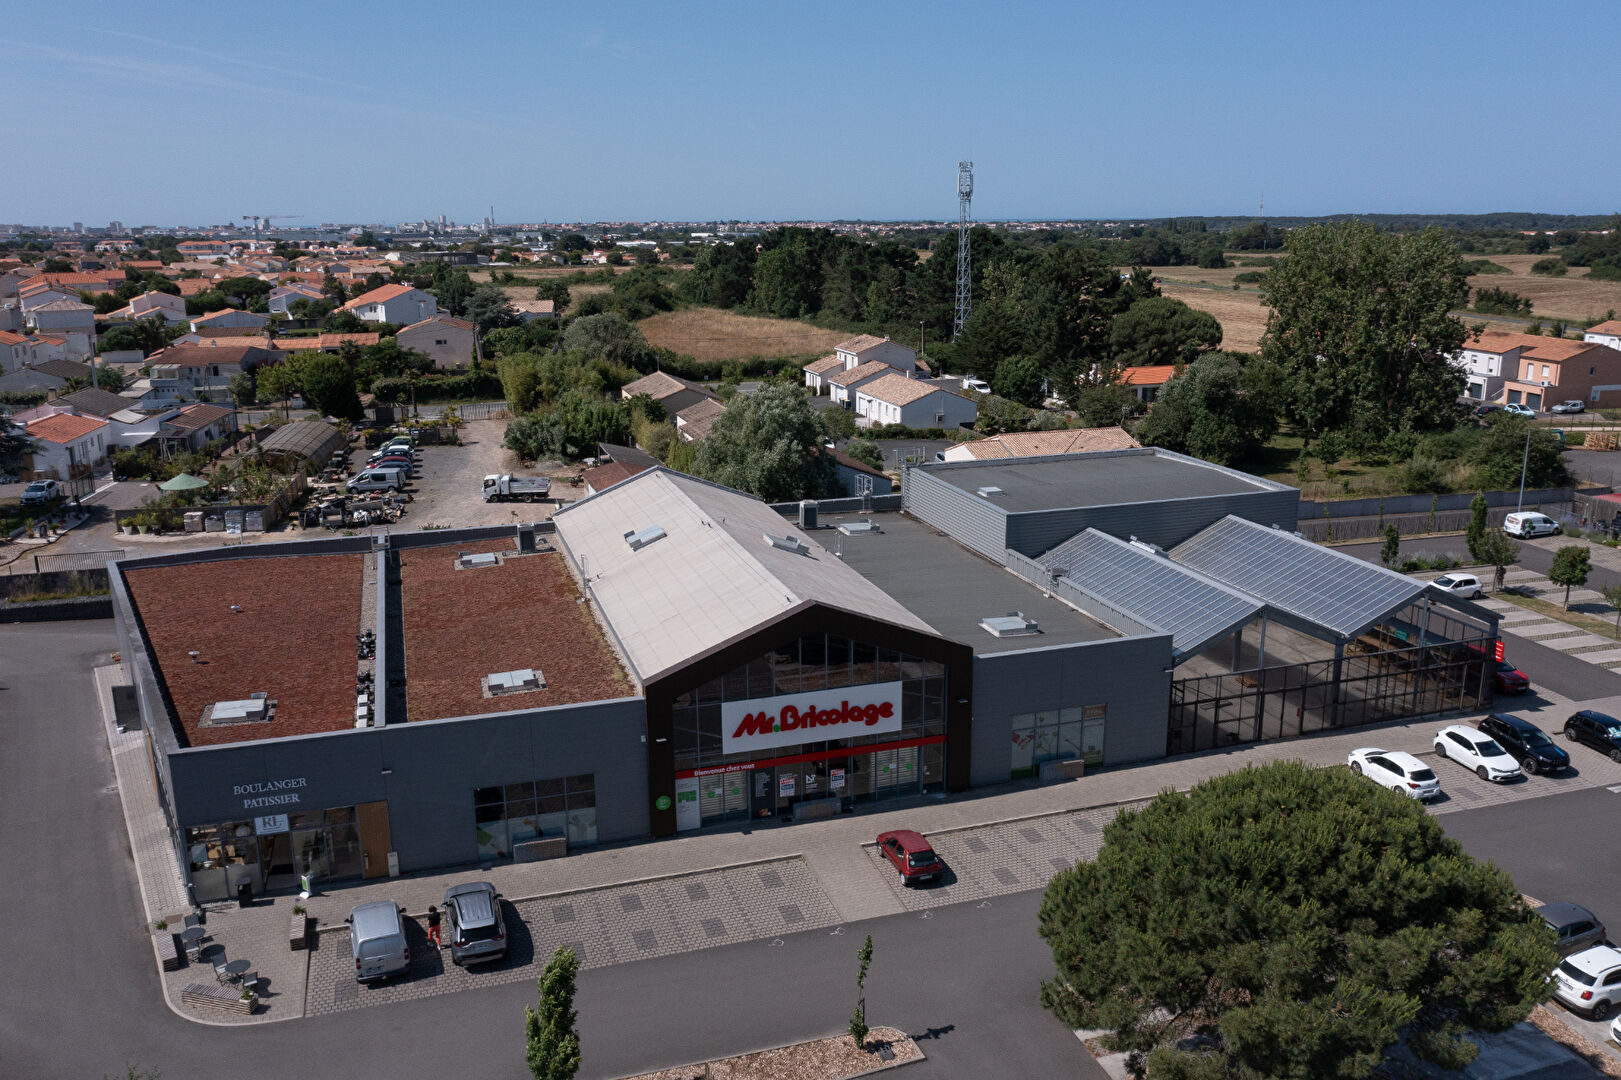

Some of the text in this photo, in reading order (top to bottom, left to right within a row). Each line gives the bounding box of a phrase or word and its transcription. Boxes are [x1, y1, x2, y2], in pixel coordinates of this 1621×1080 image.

[694, 768, 725, 776] Bienvenue
[233, 777, 308, 795] BOULANGER
[243, 793, 301, 809] PATISSIER
